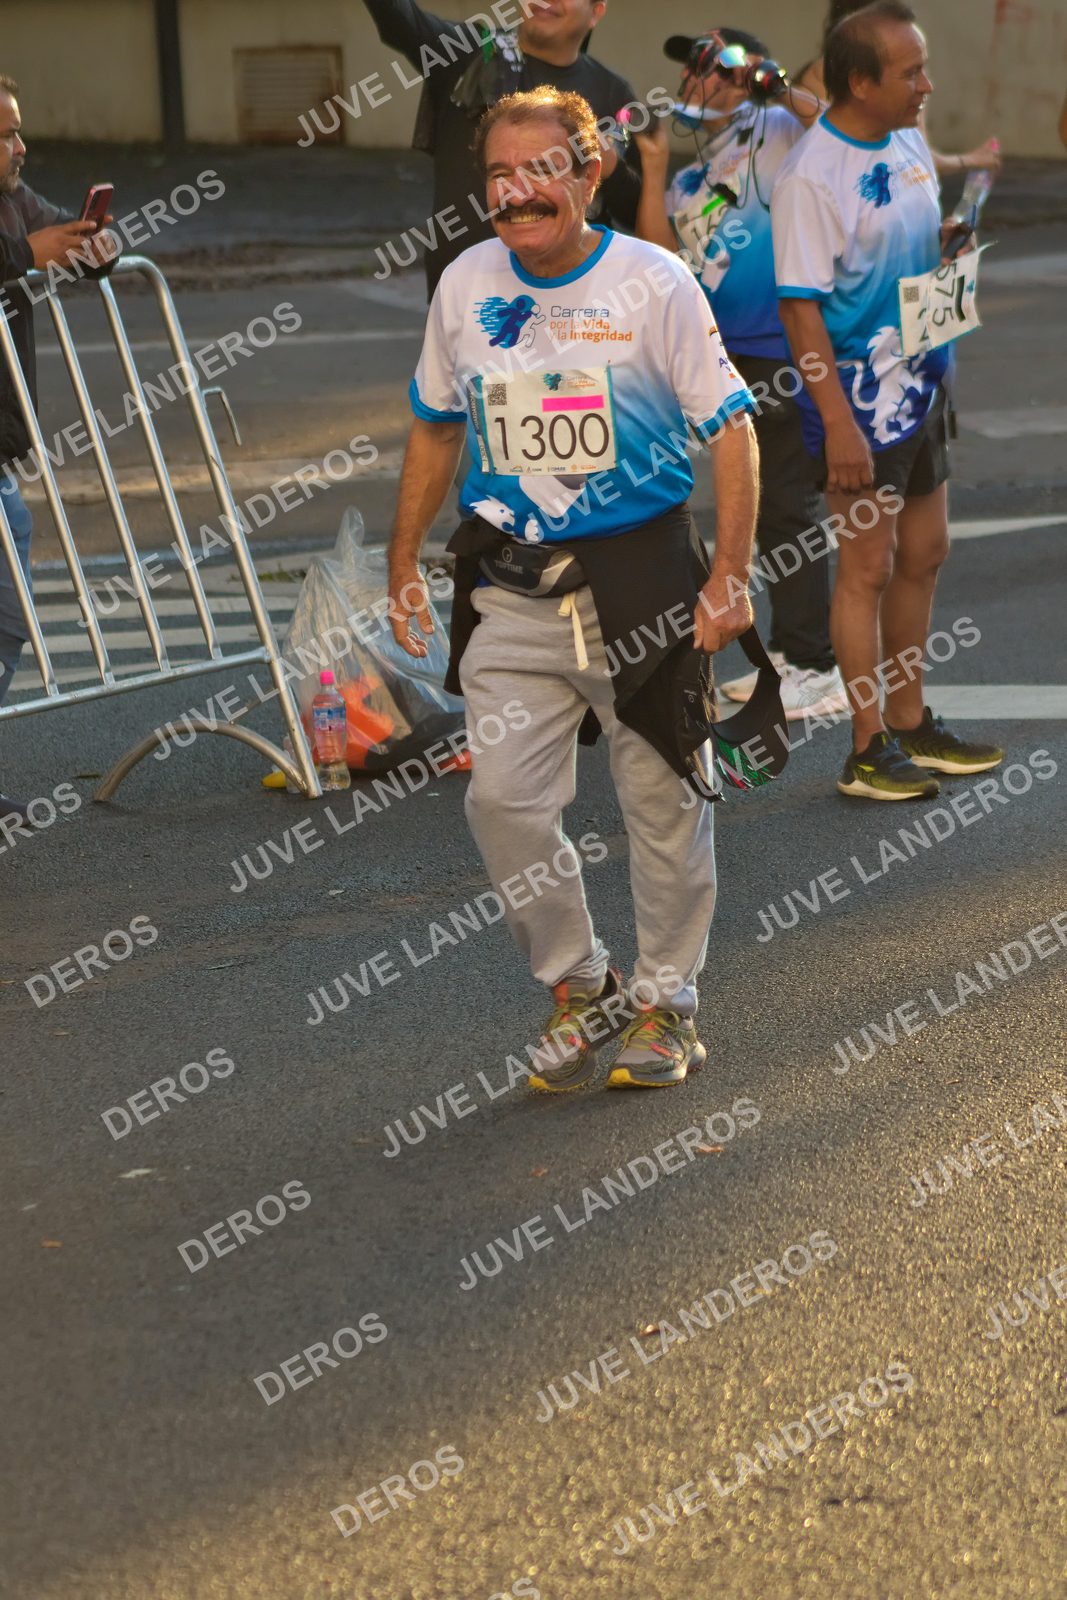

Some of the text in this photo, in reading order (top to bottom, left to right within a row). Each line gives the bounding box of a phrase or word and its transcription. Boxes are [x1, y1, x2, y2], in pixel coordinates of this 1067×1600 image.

[551, 305, 610, 318] Carrera
[550, 320, 568, 330] por
[583, 319, 610, 330] Vida
[570, 330, 633, 343] Integridad
[494, 413, 610, 461] 1300
